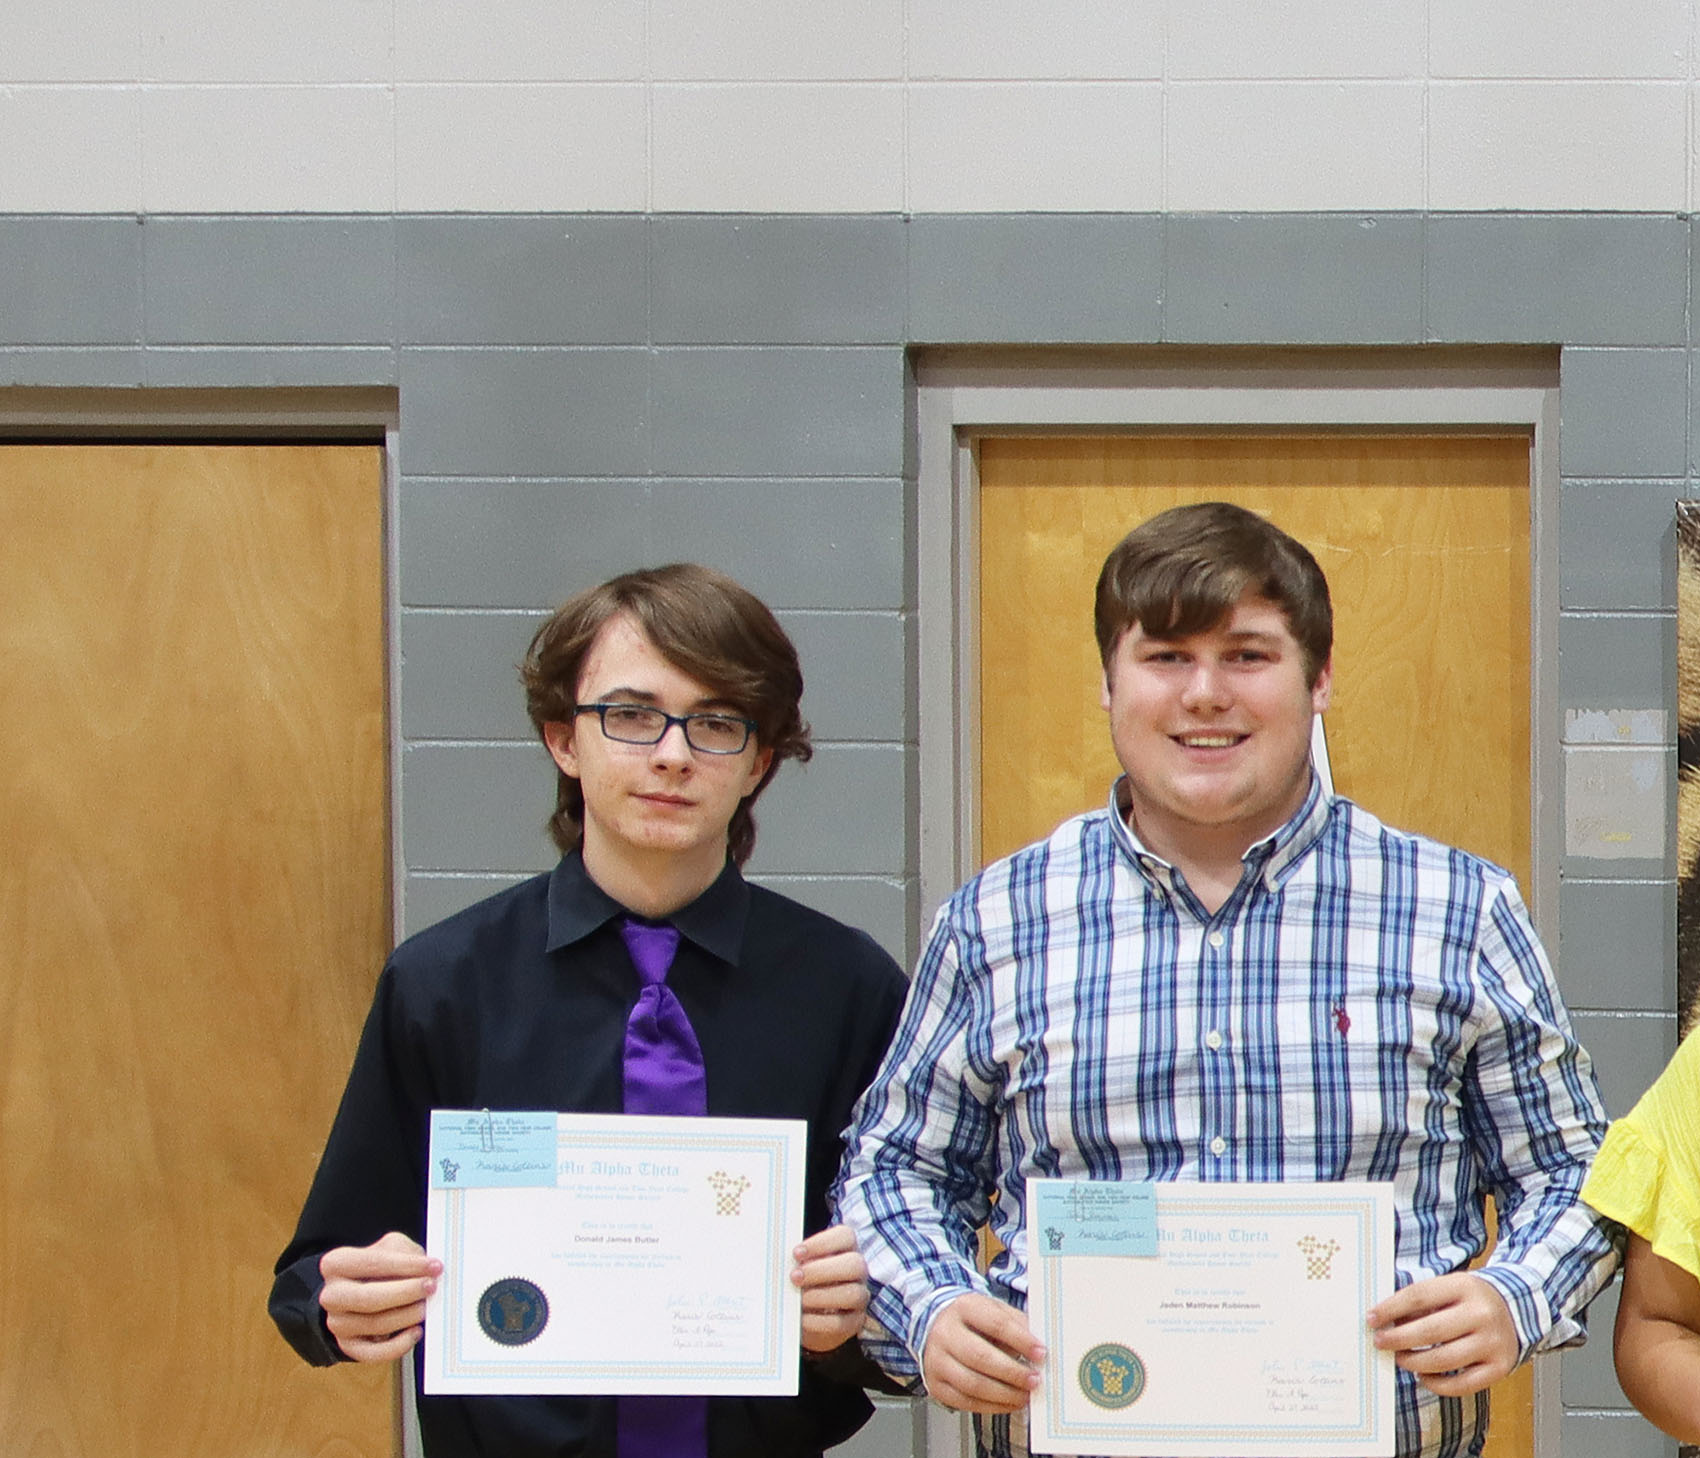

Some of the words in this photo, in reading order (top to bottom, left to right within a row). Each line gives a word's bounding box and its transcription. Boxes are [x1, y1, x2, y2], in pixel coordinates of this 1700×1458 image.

[557, 1160, 584, 1176] Mu
[591, 1160, 632, 1177] Alpha
[638, 1162, 679, 1177] Theta
[574, 1235, 603, 1243] Donald
[606, 1235, 632, 1244] James
[634, 1236, 660, 1244] Butler
[1182, 1228, 1222, 1243] Alpha
[1228, 1229, 1269, 1242] Theta
[1185, 1301, 1219, 1309] Matthew
[1221, 1301, 1261, 1309] Robinson
